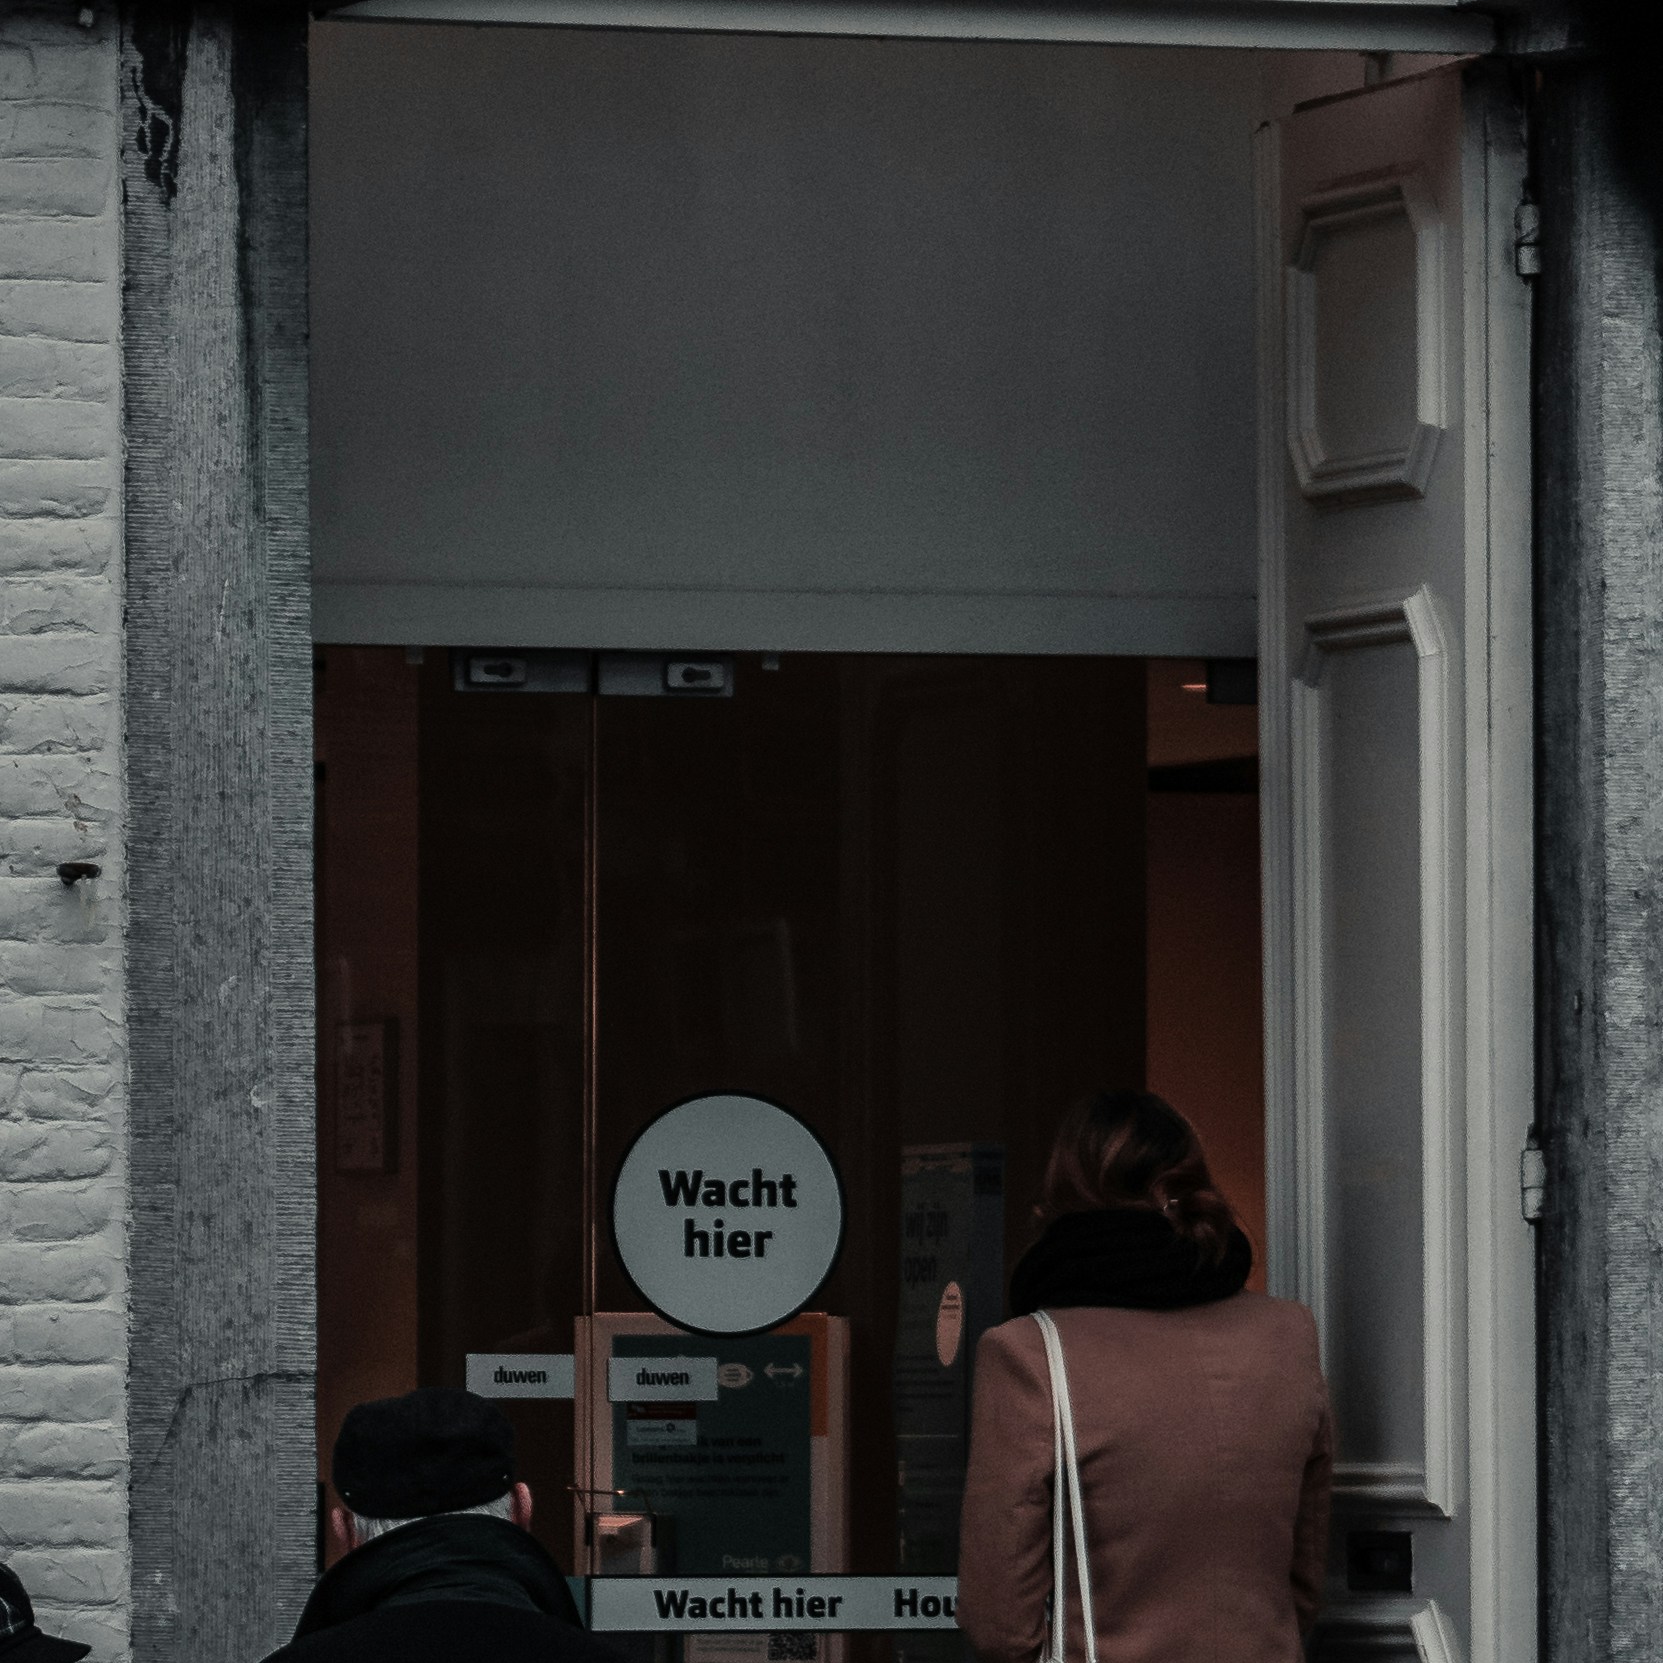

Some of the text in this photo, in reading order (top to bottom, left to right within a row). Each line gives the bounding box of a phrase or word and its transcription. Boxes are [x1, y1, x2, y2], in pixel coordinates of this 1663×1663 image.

[658, 1168, 797, 1207] Wacht
[684, 1218, 773, 1258] hier
[494, 1365, 547, 1384] duwen
[636, 1367, 689, 1386] duwen
[722, 1554, 768, 1569] Pearle
[653, 1587, 763, 1619] Wacht
[772, 1587, 843, 1618] hier
